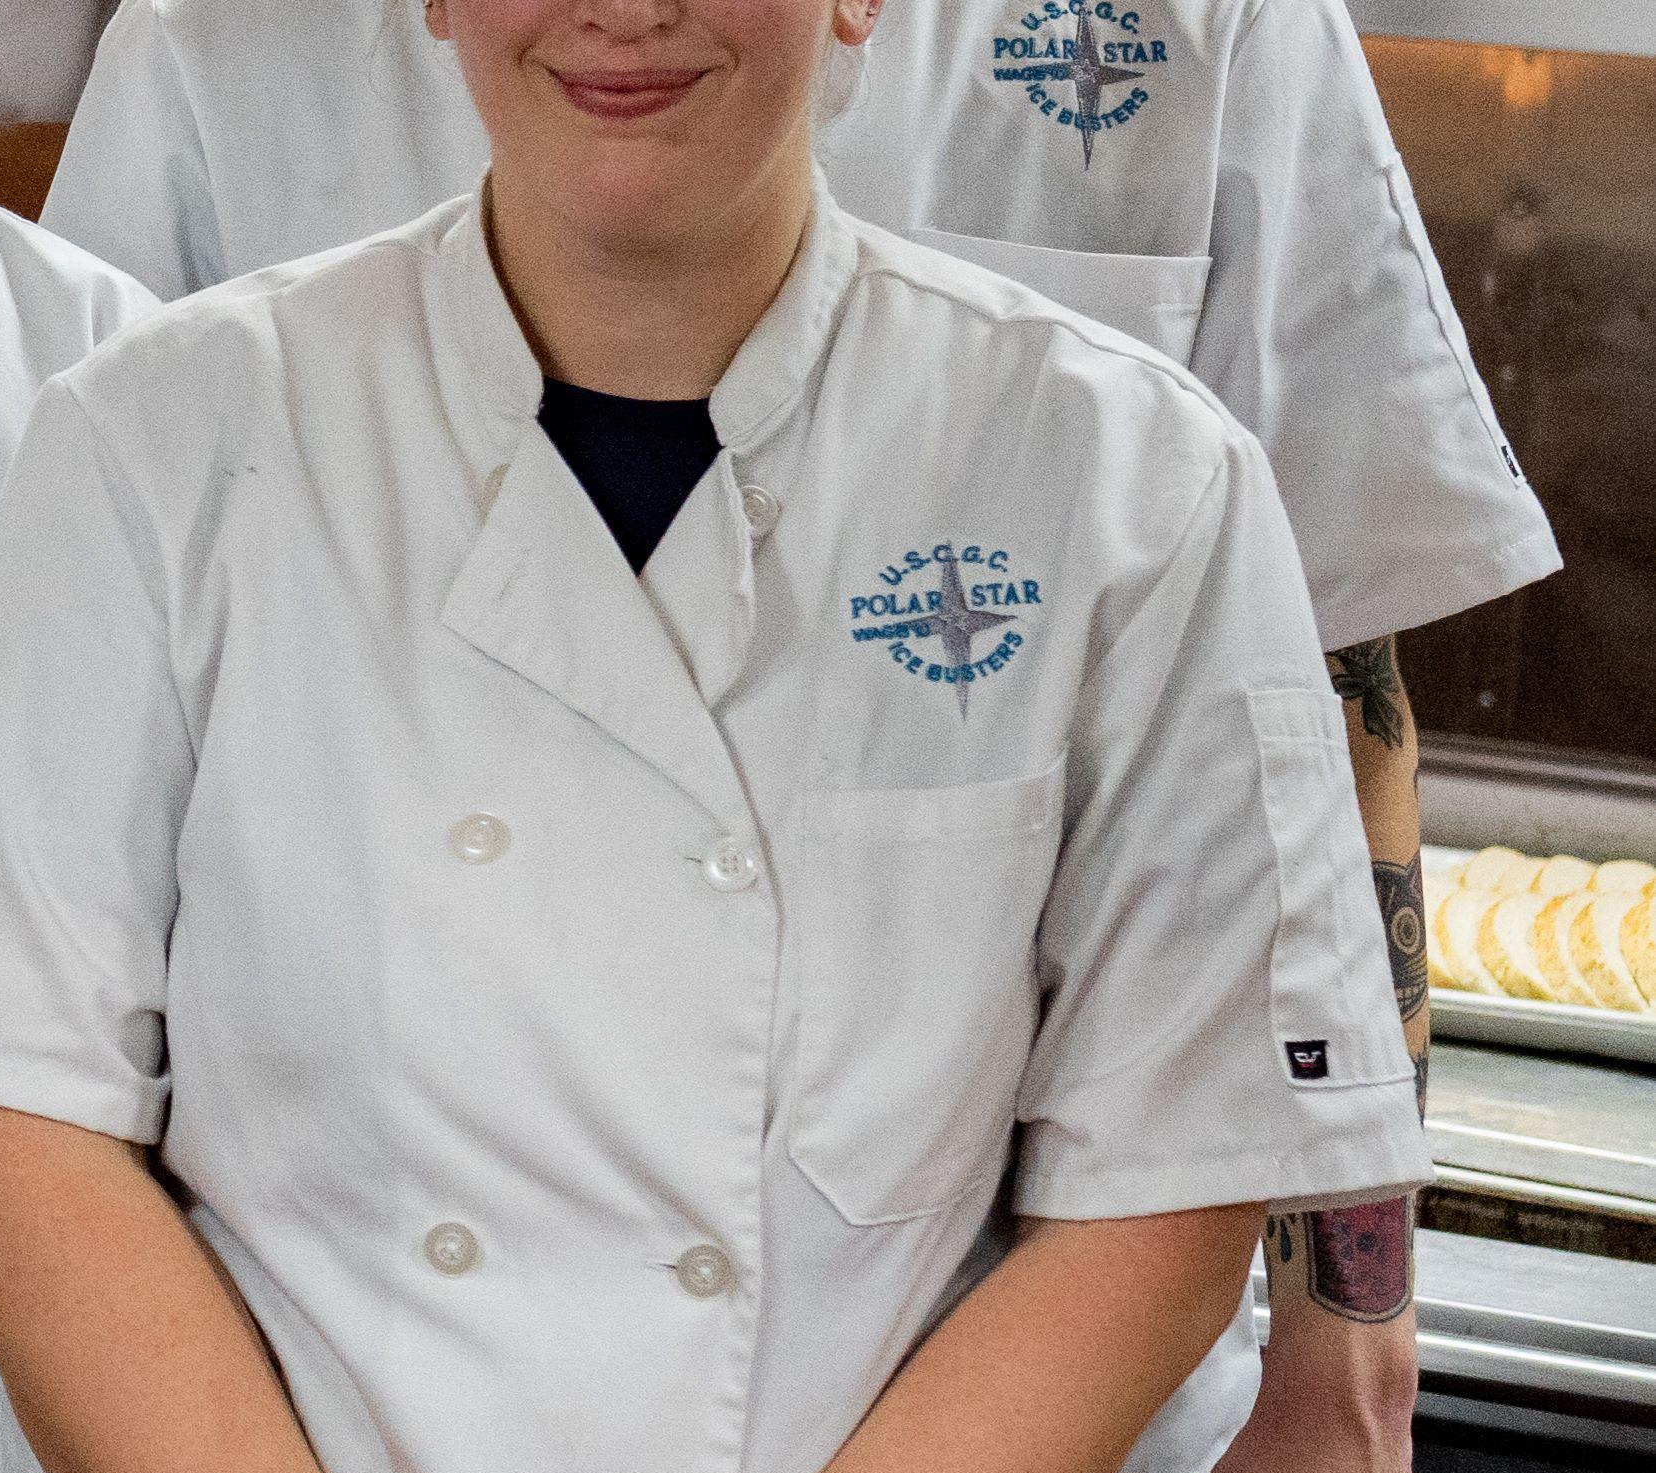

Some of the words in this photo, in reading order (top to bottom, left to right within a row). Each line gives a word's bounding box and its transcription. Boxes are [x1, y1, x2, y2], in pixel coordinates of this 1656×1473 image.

[993, 36, 1077, 60] POLAR
[1103, 40, 1168, 64] STAR
[850, 590, 942, 619] POLAR
[971, 579, 1042, 607] STAR
[888, 640, 924, 675] ICE
[925, 630, 1024, 683] BUSTERS
